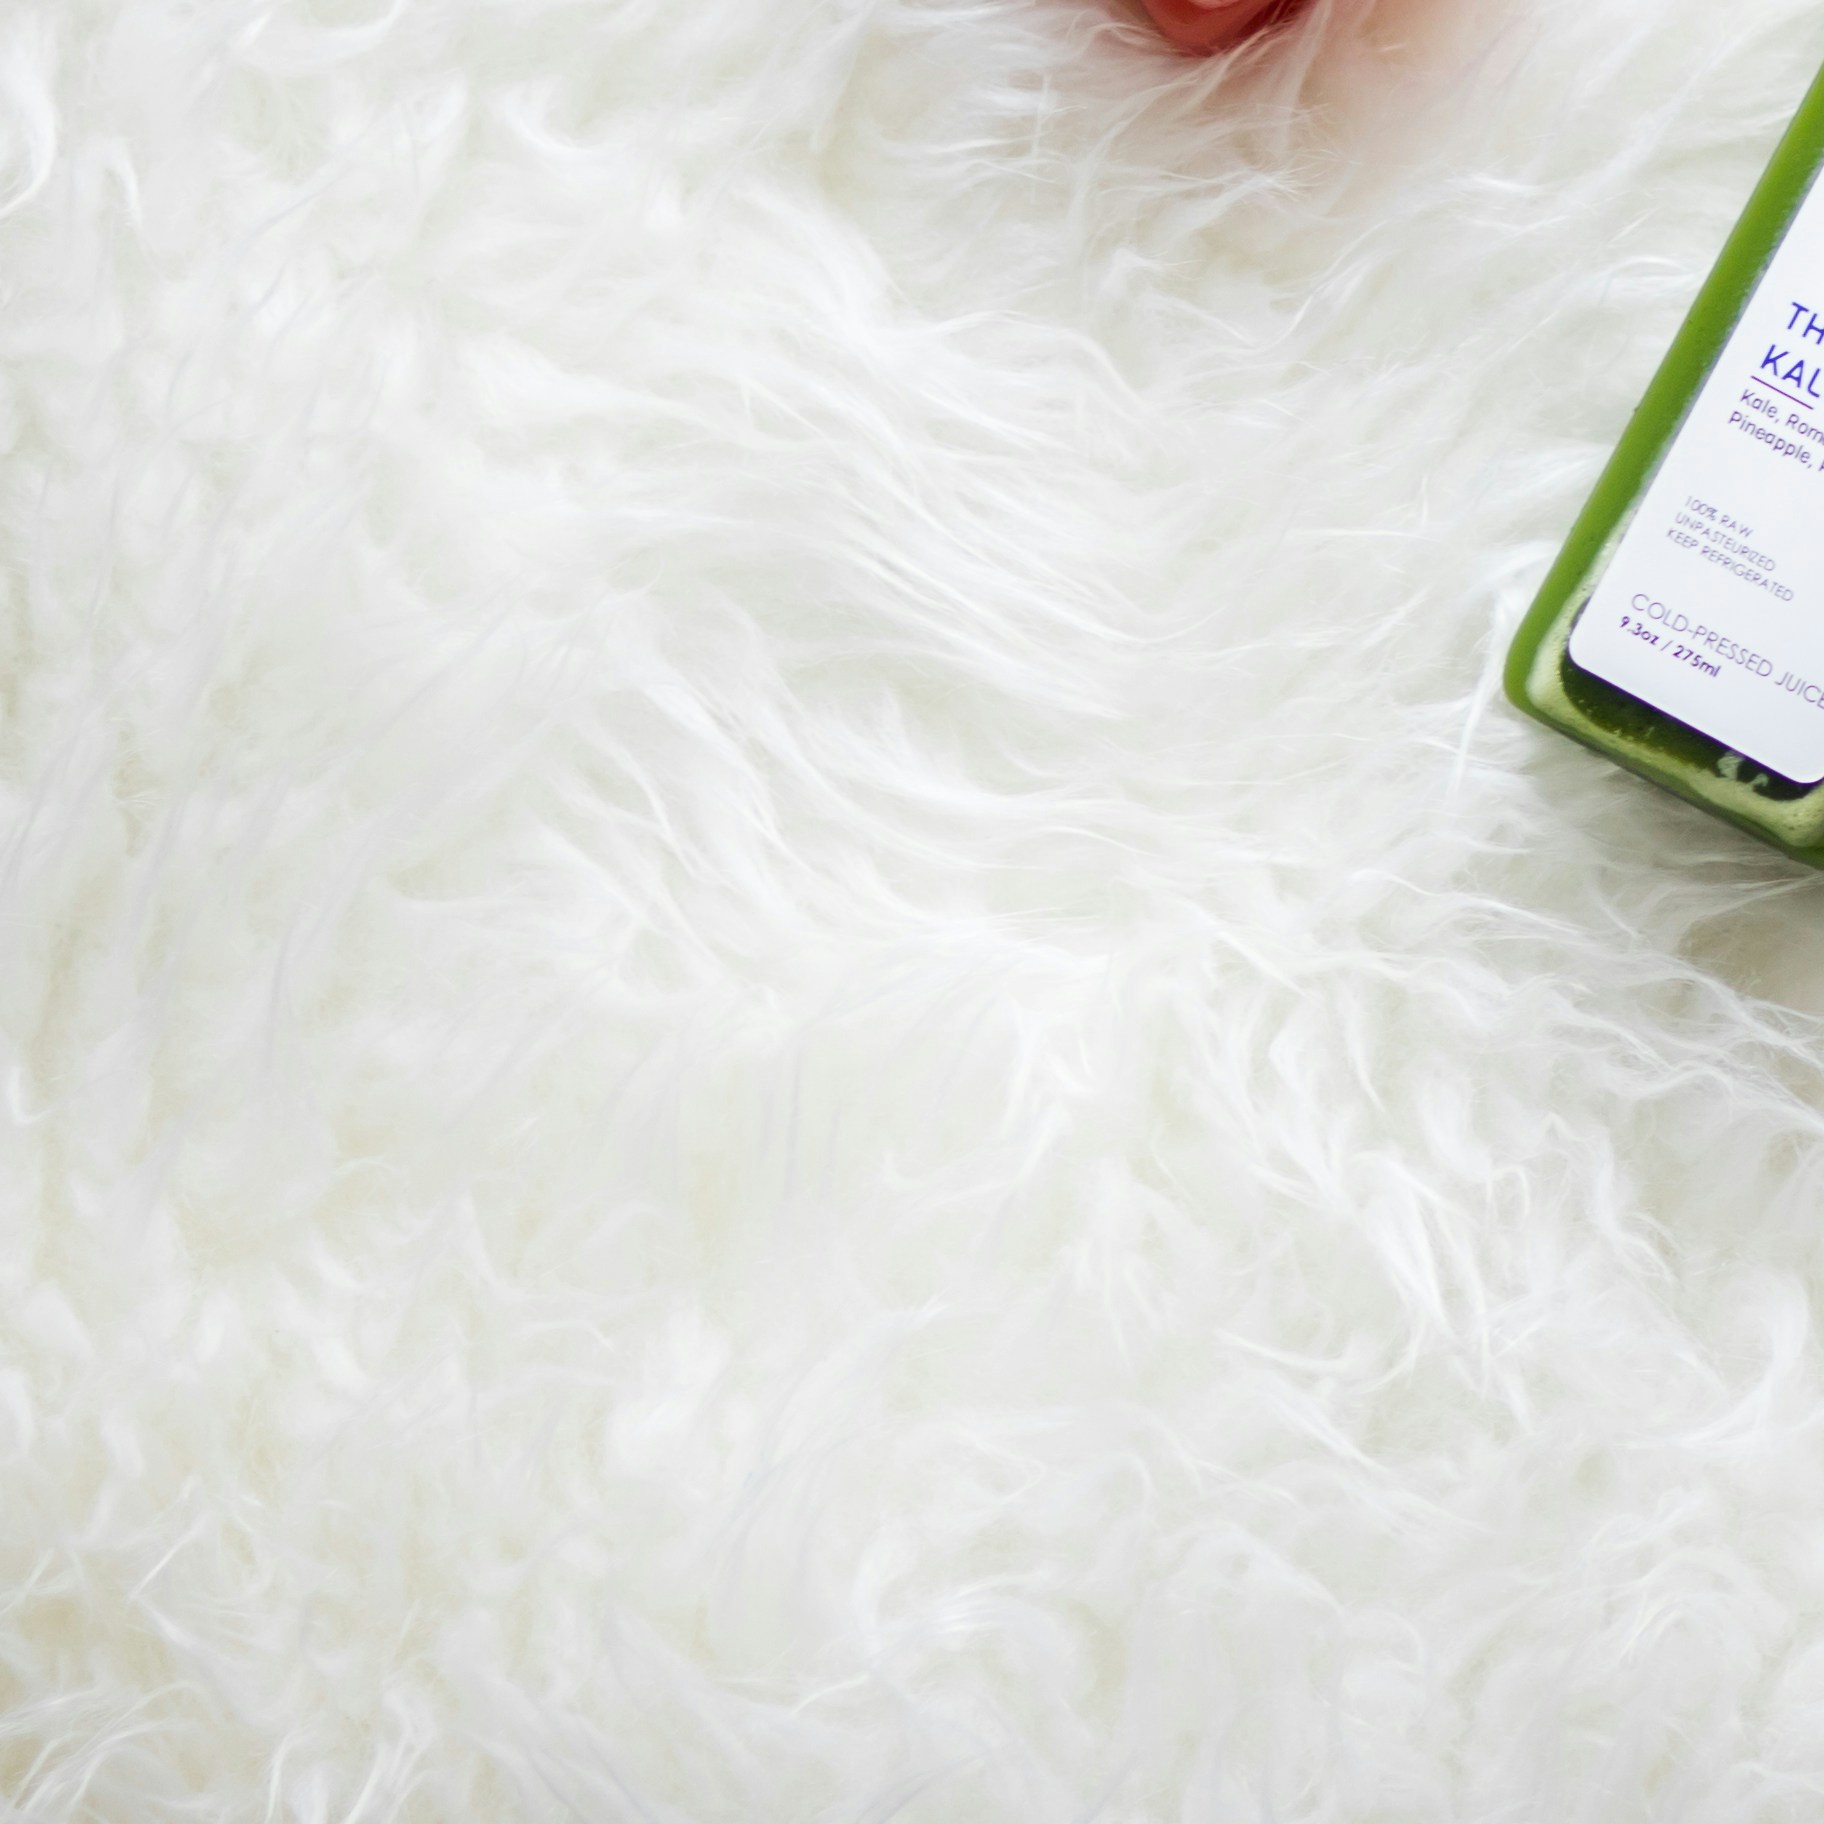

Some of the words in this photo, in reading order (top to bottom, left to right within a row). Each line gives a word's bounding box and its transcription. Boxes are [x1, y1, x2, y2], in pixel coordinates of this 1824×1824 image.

[1740, 389, 1779, 423] Kale,
[1728, 411, 1812, 468] Pineapple,
[1675, 512, 1776, 571] UNPASTEURIZED
[1685, 496, 1718, 521] 100%
[1719, 515, 1753, 538] RAW
[1666, 528, 1699, 549] KEEP
[1700, 545, 1794, 601] REFRIGERATED
[1620, 616, 1659, 645] 9.3oz
[1672, 645, 1721, 677] 275ml
[1631, 594, 1773, 677] COLD-PRESSED
